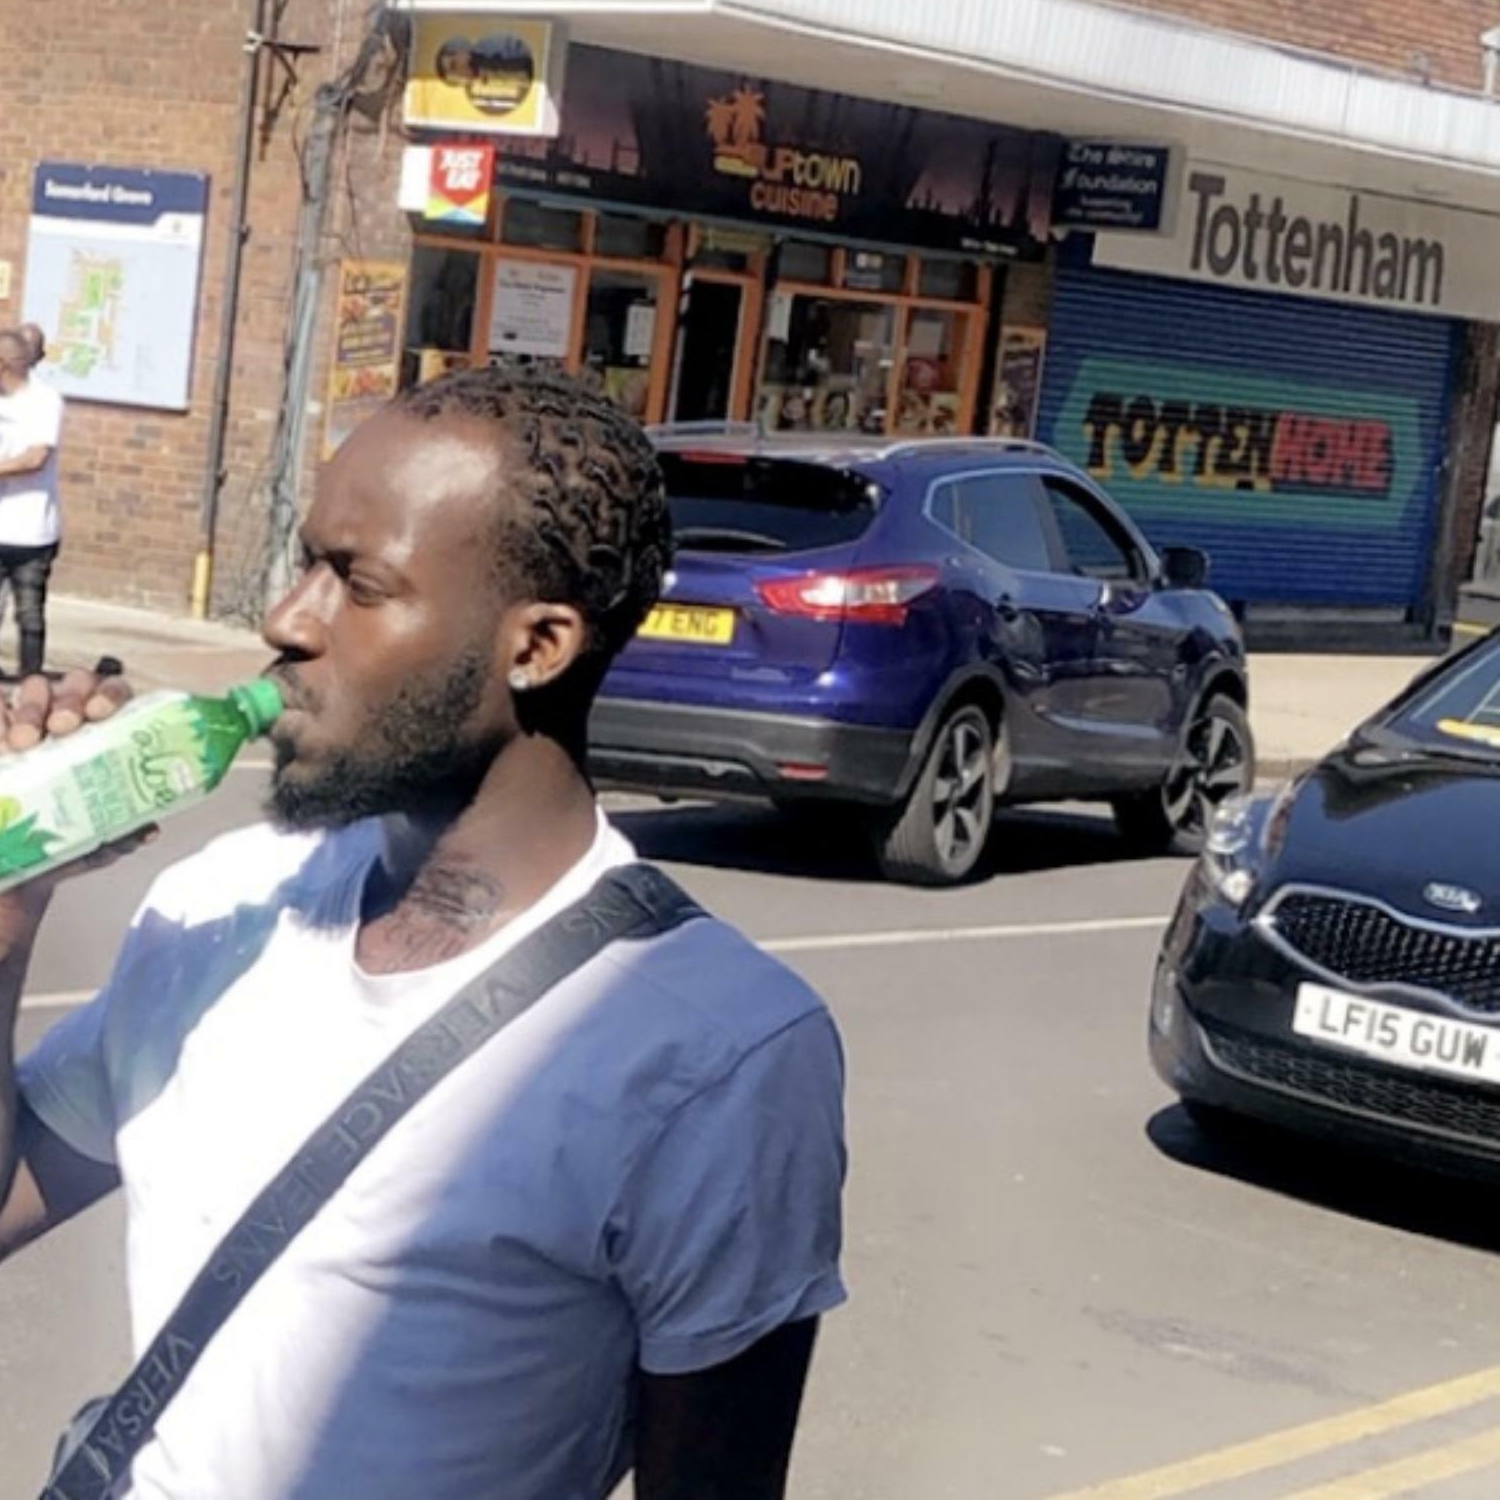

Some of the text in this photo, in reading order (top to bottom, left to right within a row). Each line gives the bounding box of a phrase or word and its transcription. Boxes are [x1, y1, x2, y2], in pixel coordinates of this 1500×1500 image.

[1188, 172, 1444, 306] Tottenham
[670, 608, 719, 637] ENG
[1318, 995, 1490, 1070] LF15 GUW
[212, 978, 526, 1290] VERSACE JEANS
